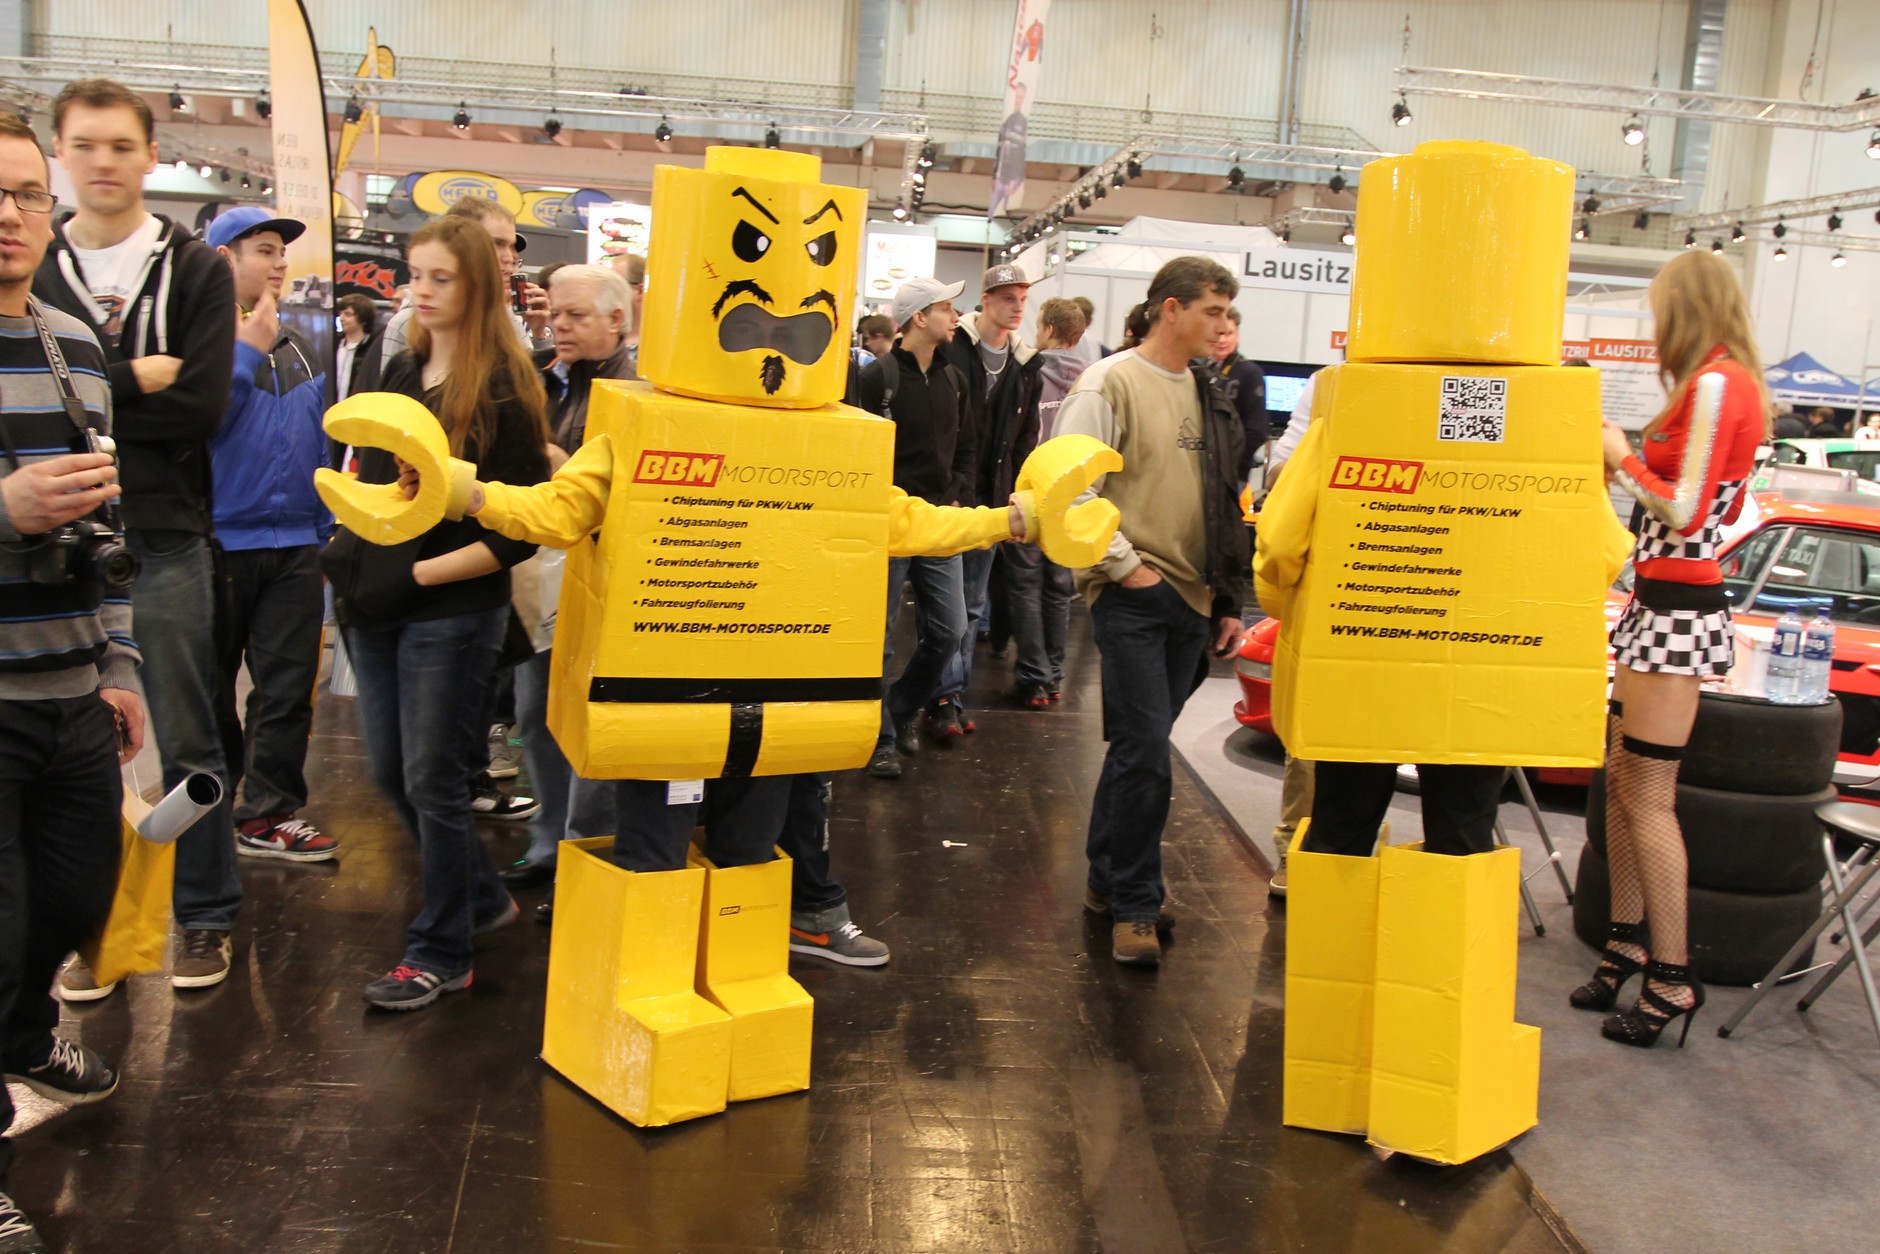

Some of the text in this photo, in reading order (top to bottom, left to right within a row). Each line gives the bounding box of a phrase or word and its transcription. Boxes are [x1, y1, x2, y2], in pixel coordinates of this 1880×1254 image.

[1244, 252, 1350, 284] Lausitz
[1594, 343, 1657, 359] LAUSITZ
[635, 453, 872, 489] BBM MOTORSPORT
[1334, 460, 1588, 495] BBM MOTORSPORT
[671, 496, 814, 511] Chiptuning für PKW/LKW
[1369, 501, 1521, 518] Chiptuning für PKW/LKW
[666, 516, 748, 529] Abgasanlagen
[1364, 521, 1450, 535] Abgasanlagen
[660, 537, 741, 550] Bremsanlagen
[1357, 541, 1443, 556] Bremsanlagen
[654, 557, 760, 570] Gewindefahrwerke
[1352, 561, 1463, 577] Gewindefahrwerke
[647, 578, 758, 590] Motorsportzubehör
[1344, 582, 1461, 597] Motorsportzubehör
[640, 598, 745, 611] Fahrzeugfolierung
[1338, 602, 1448, 618] Fahrzeugfolierung
[633, 621, 832, 635] WWW.BBM-MOTORSPORT.DE
[1330, 624, 1544, 648] WWW.BBM-MOTORSPORT.DE
